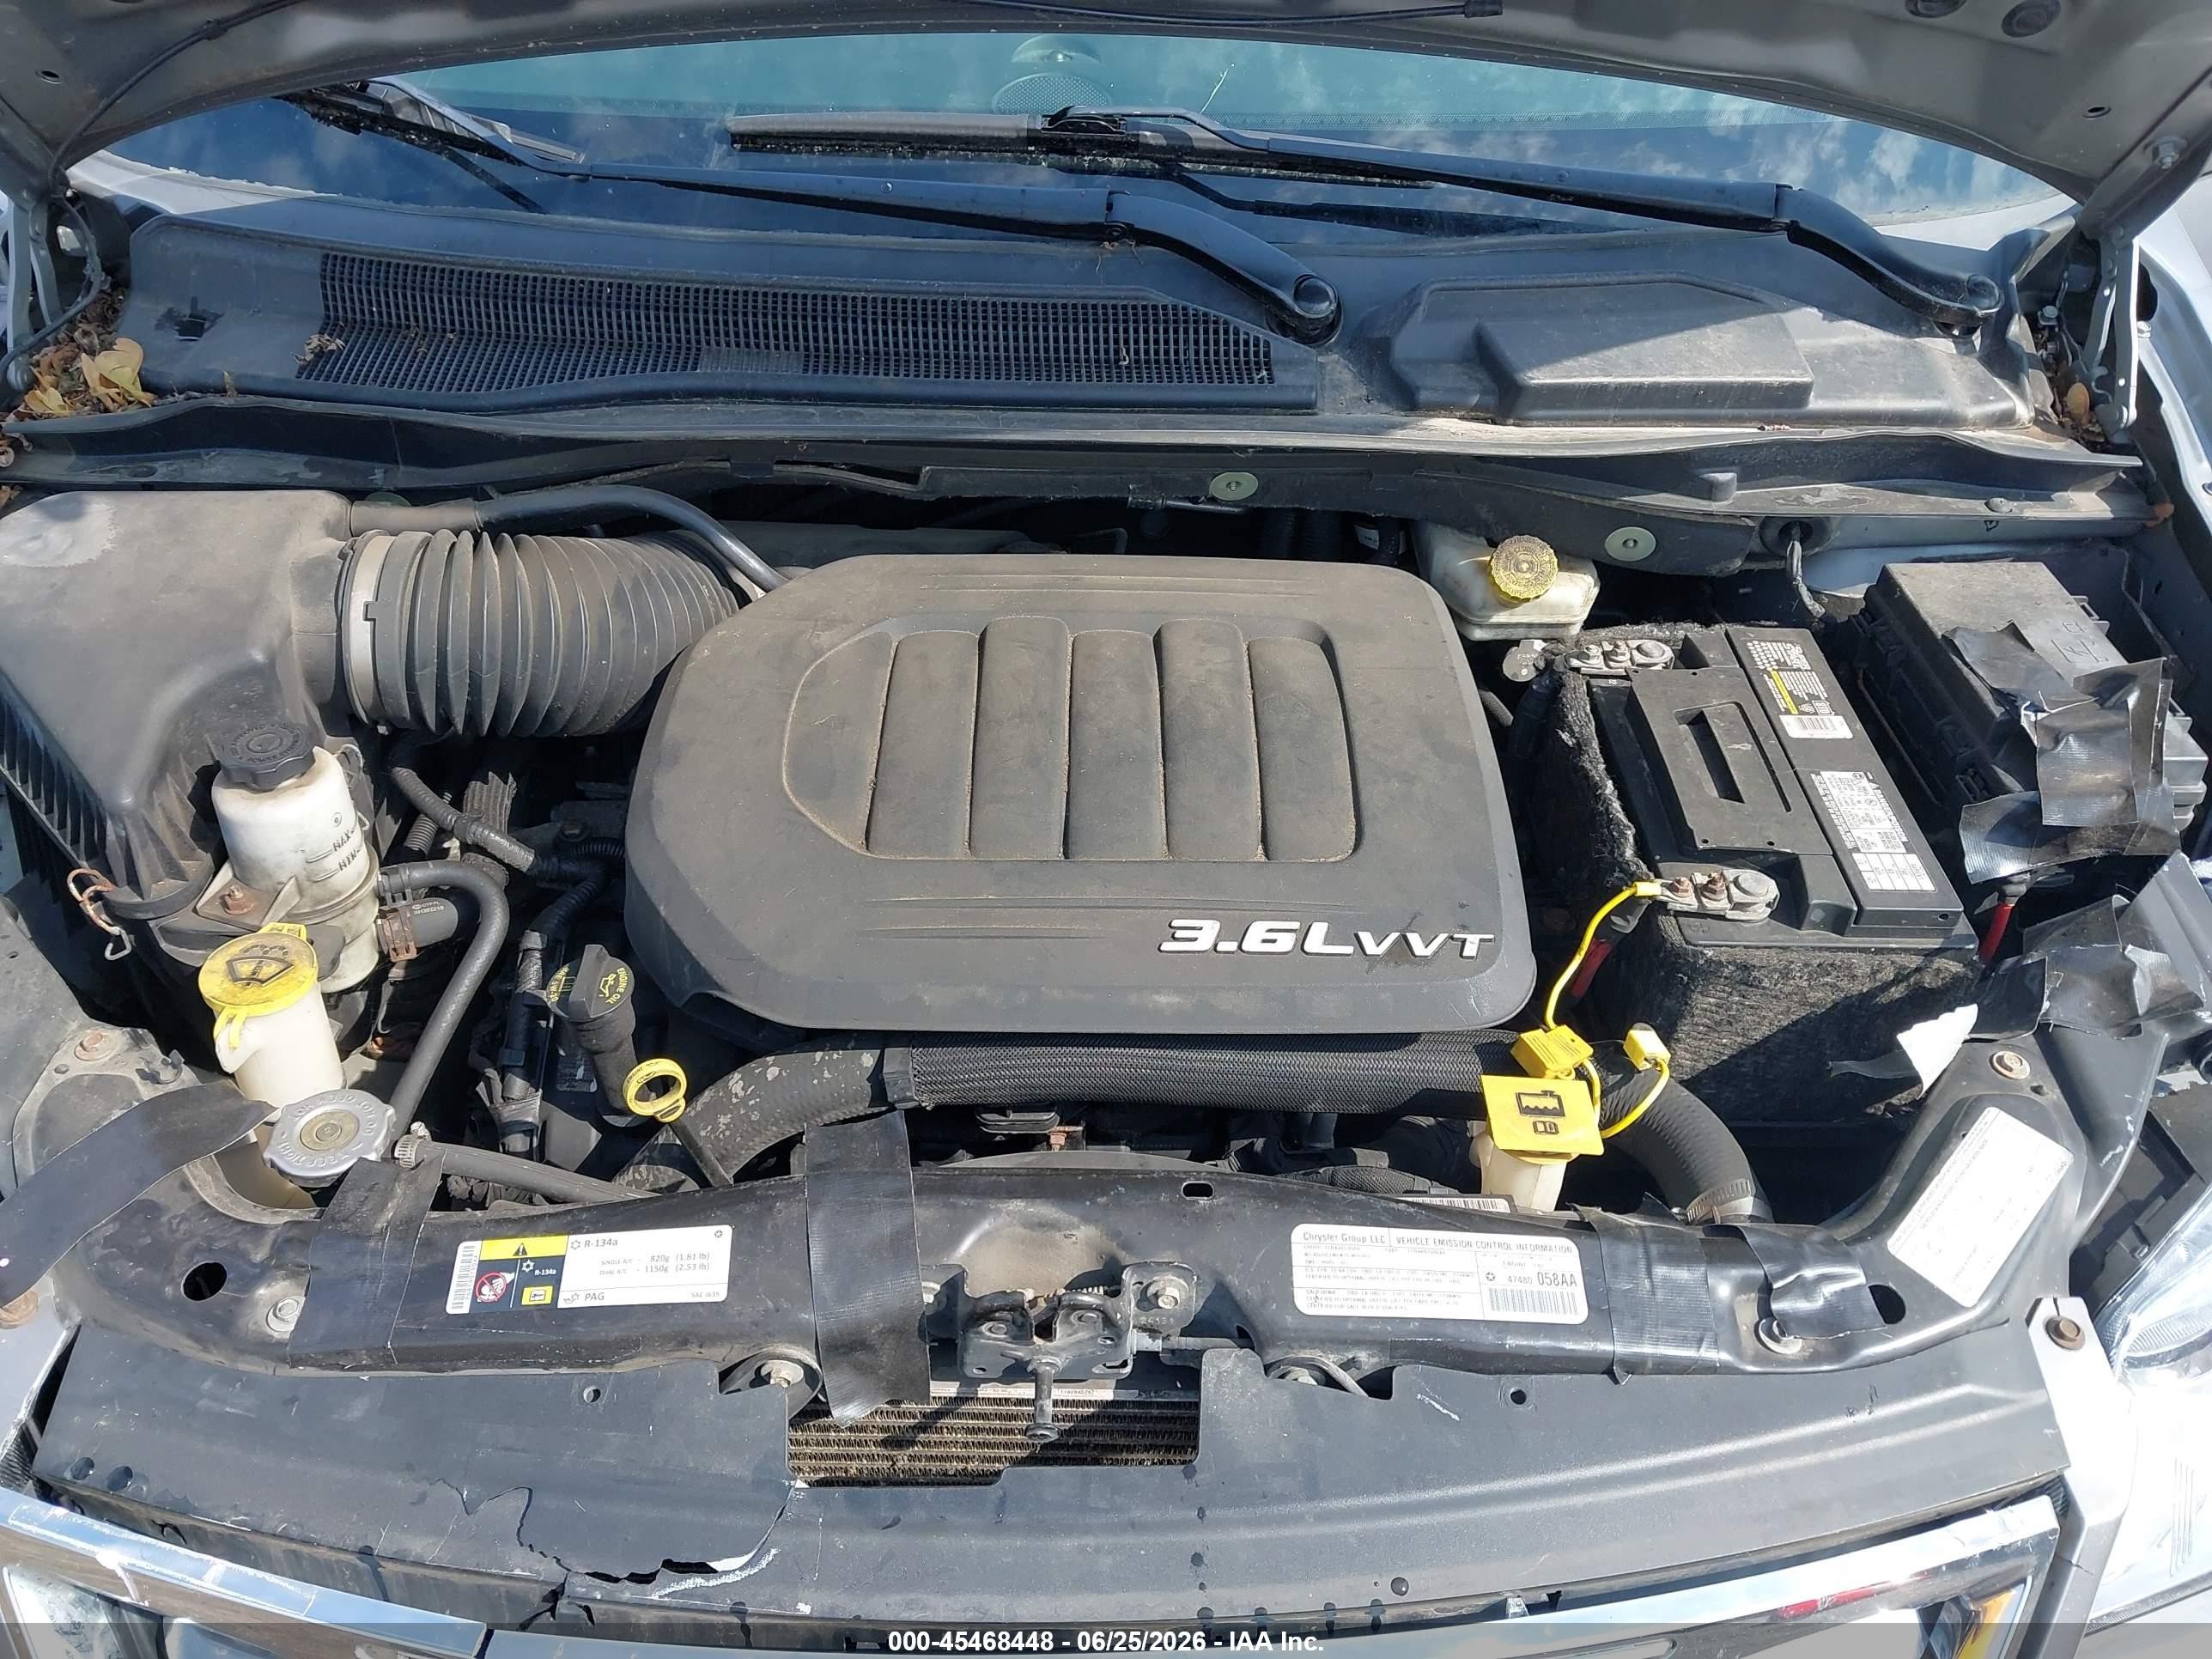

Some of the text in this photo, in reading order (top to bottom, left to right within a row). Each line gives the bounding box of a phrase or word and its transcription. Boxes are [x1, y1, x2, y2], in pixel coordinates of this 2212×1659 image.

[1158, 919, 1495, 960] 3.6L VVT
[605, 967, 629, 1004] ENGINE OIL
[584, 1238, 618, 1249] R-134a
[1304, 1232, 1385, 1244] Chrysler Group LLC
[1396, 1237, 1572, 1254] VEHICLE EMISSION CONTROL INFORMATION
[650, 1254, 670, 1264] 820g
[698, 1252, 709, 1261] lb)
[645, 1265, 669, 1273] 1150g
[675, 1263, 696, 1273] (2.53
[698, 1262, 709, 1271] lb)
[1536, 1271, 1577, 1287] 058AA
[584, 1291, 605, 1302] PAG
